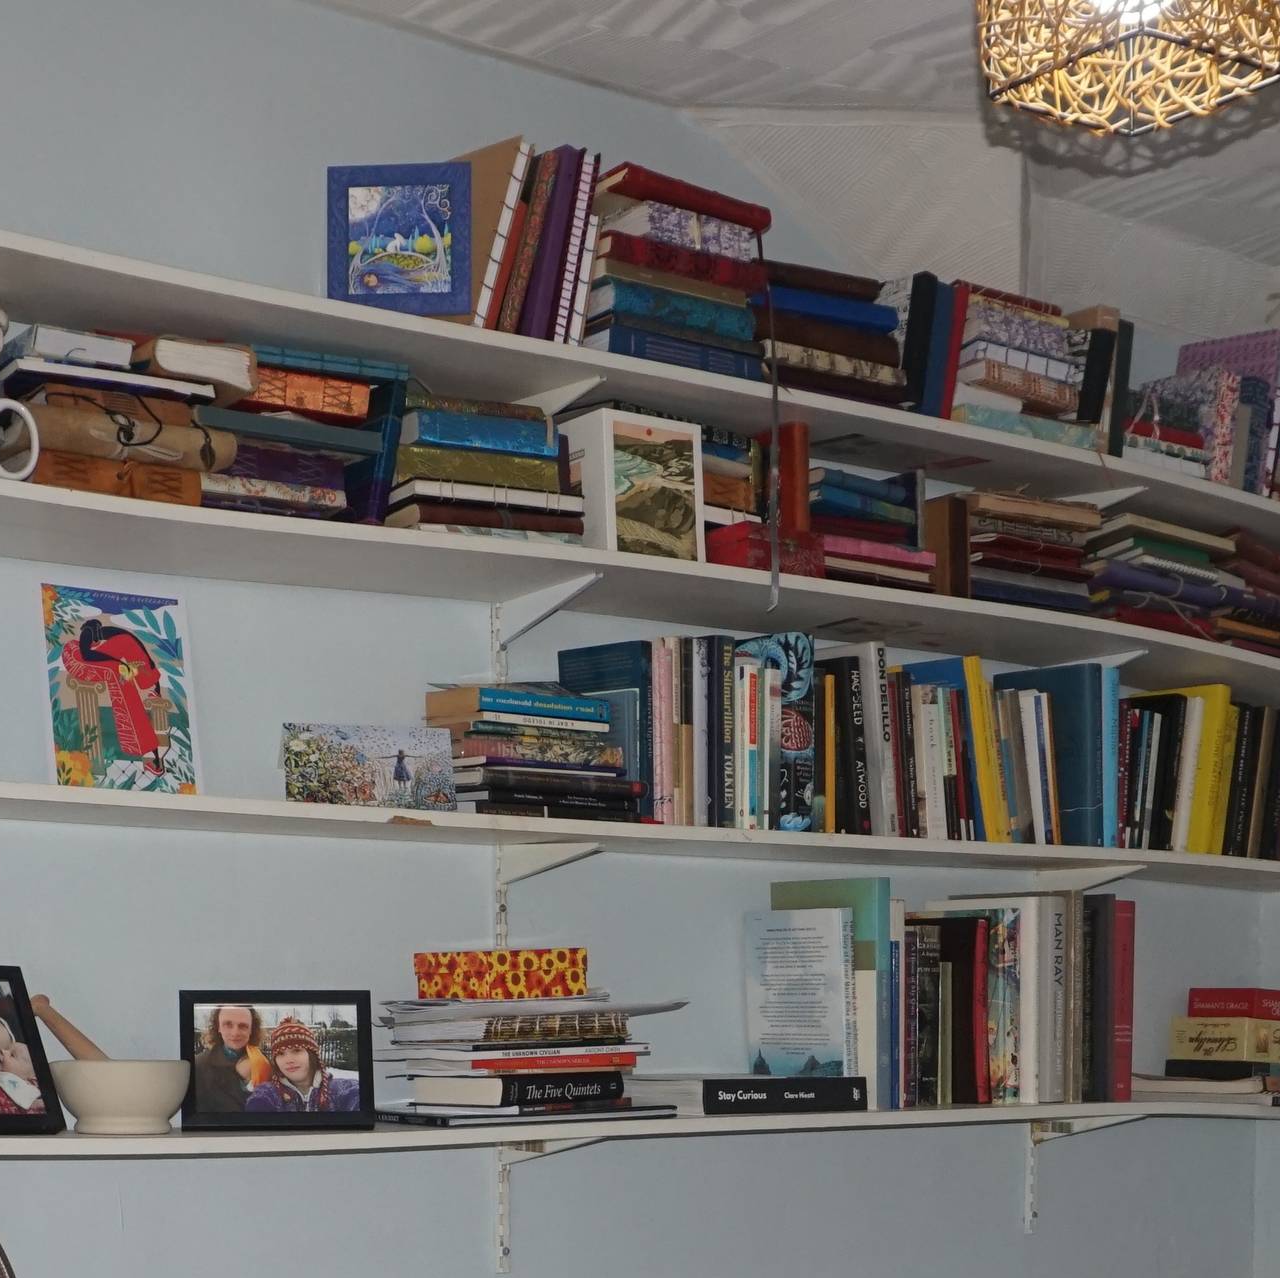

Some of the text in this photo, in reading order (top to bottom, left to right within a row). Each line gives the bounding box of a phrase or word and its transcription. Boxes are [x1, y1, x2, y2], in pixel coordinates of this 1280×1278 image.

[877, 647, 885, 680] DON
[723, 644, 734, 809] The Silmarillion TOLKIEN
[879, 684, 891, 742] DELILLO
[851, 670, 866, 808] HAG-SEED ATWOOD
[1054, 913, 1063, 950] MAN
[1054, 955, 1063, 986] RAY
[526, 1084, 543, 1100] The
[545, 1084, 562, 1098] Five
[565, 1079, 601, 1096] Quintets
[718, 1091, 736, 1102] Stay
[737, 1091, 767, 1100] Curious
